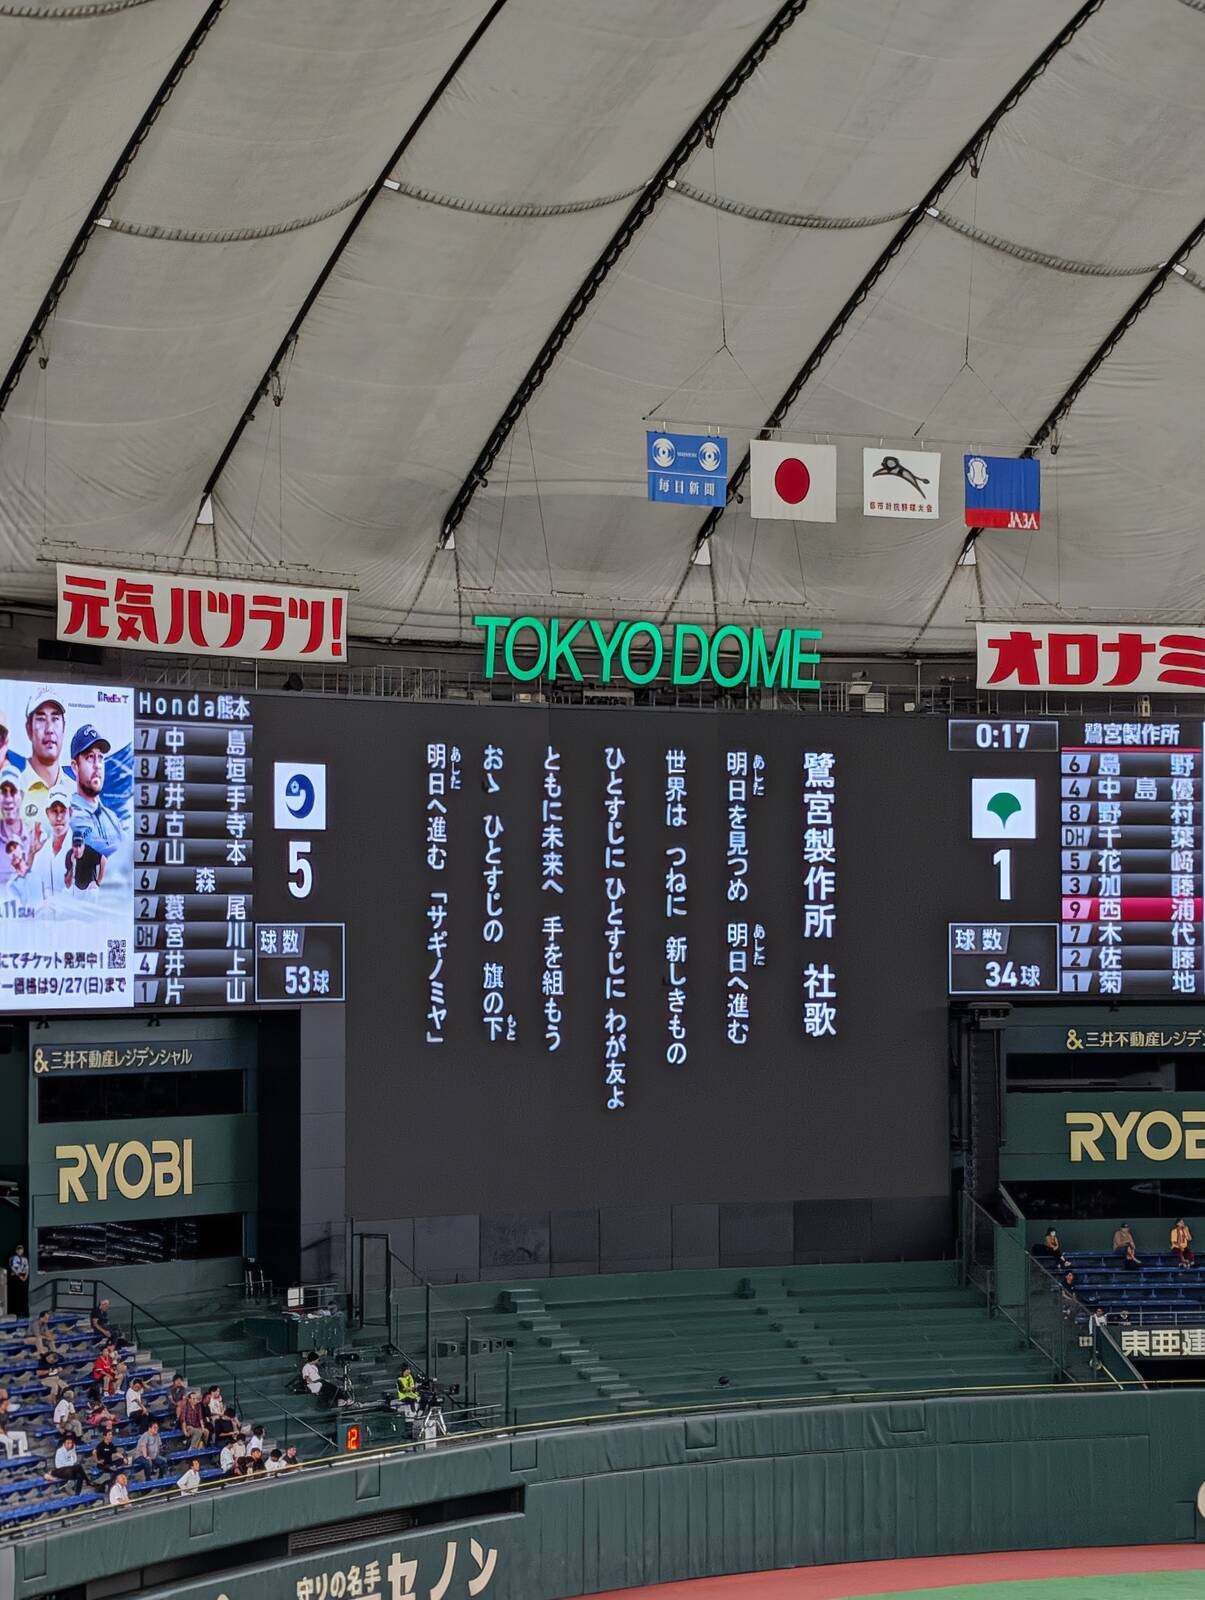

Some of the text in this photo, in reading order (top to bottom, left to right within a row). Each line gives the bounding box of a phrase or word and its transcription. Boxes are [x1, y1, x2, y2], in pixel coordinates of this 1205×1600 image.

[659, 478, 715, 496] 毎日新聞
[474, 615, 822, 689] TOKYO DOME
[140, 730, 150, 750] 7
[976, 724, 1030, 748] 0:17
[1084, 723, 1180, 746] 鷺宮製作所
[140, 758, 150, 776] 8
[450, 747, 461, 790] あした
[1070, 756, 1080, 772] 6
[753, 755, 764, 796] あした
[140, 786, 150, 806] 5
[1070, 780, 1080, 797] 4
[1070, 805, 1080, 821] 8
[140, 815, 150, 834] 3
[1065, 828, 1085, 845] DH
[140, 842, 150, 861] 9
[1070, 853, 1080, 870] 5
[140, 867, 215, 892] 6 森
[287, 841, 313, 898] 5
[483, 814, 504, 943] ひとすじの
[992, 849, 1011, 900] 1
[427, 743, 447, 1043] 明日へ進む 「サギノミヤ」
[803, 752, 837, 1037] 鷺宮製作所 社歌
[1070, 878, 1080, 894] 3
[140, 898, 150, 917] 2
[542, 747, 565, 1051] ともに未来へ 手を組もう
[665, 749, 688, 1065] 世界は つねに 新しきもの
[726, 751, 749, 1045] 明日を見つめ 明日へ進む
[1070, 902, 1080, 918] 9
[137, 926, 154, 946] DH
[605, 747, 626, 1110] ひとすじに ひとすじに わが友よ
[1070, 926, 1080, 943] 7
[260, 930, 299, 953] 球数
[753, 923, 765, 966] あした
[955, 929, 1003, 951] 球数
[140, 954, 150, 972] 4
[1070, 950, 1080, 966] 2
[141, 982, 148, 1002] 1
[1071, 975, 1079, 992] 1
[483, 963, 504, 1041] 旗の下
[506, 1013, 516, 1041] もと
[51, 1048, 192, 1070] 三井不動産レジデンシャル
[55, 1138, 193, 1203] RYOBI
[297, 1561, 381, 1600] 守りの名手
